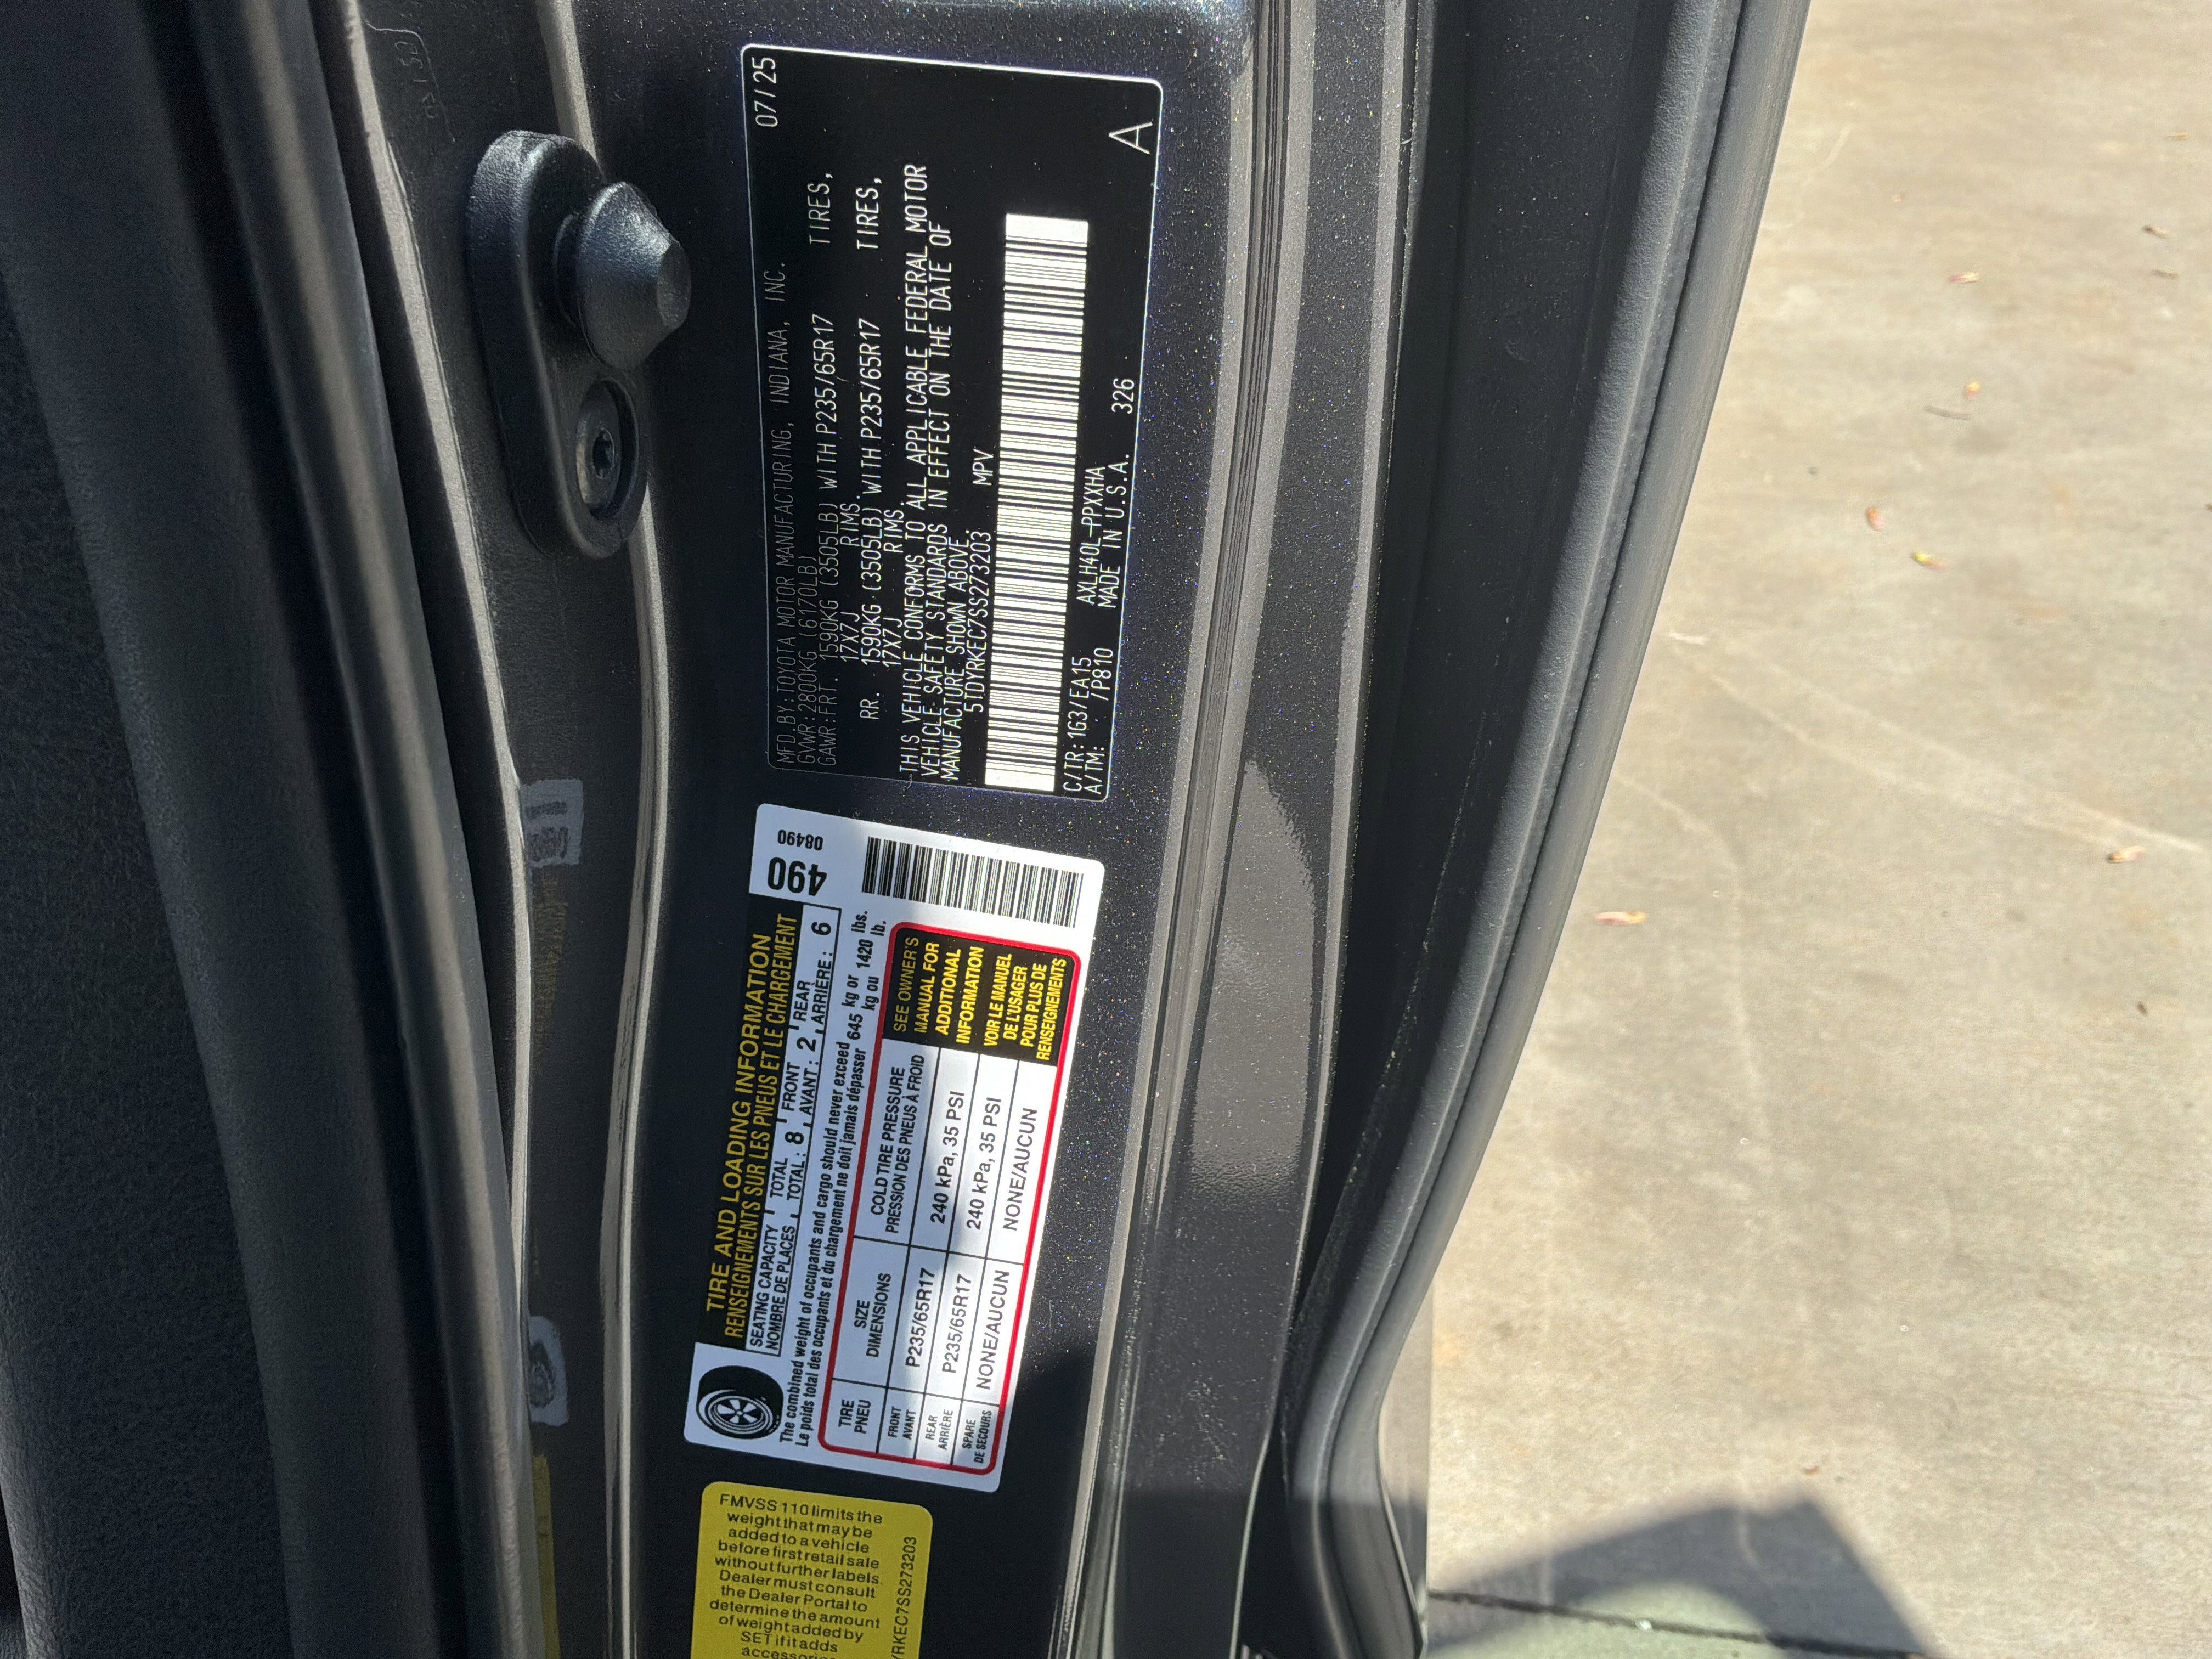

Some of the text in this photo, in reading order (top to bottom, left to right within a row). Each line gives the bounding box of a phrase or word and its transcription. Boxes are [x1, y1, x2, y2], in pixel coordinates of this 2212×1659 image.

[752, 56, 778, 127] 07/25
[1108, 119, 1153, 154] A
[763, 261, 798, 627] MOTOR MANUFACTURING, INDIANA, INC.
[807, 171, 839, 661] 1590KG (3505LB) WITH P235/65R17 TIRES,
[856, 176, 882, 719] RR. 1590KG (3505LB) WITH P235/65R17 TIRES,
[900, 163, 928, 773] THIS VEHICLE CONFORMS TO ALL APPLICABLE FEDERAL MOTOR
[921, 220, 952, 777] VEHICLE SAFETY STANDARDS IN EFFECT ON THE DATE OF
[1097, 378, 1135, 607] MADE IN U.S.A. 326
[1076, 465, 1105, 605] AXLH40L-PPXXHA
[796, 556, 818, 637] (6170LB)
[839, 494, 860, 662] 17X7J RIMS.
[964, 449, 994, 712] 5TDYRKEC7SS273203 MPV
[940, 528, 969, 782] MANUFACTURE SHOWN ABOVE.
[767, 856, 828, 898] 490
[777, 829, 823, 851] 08490
[810, 921, 832, 936] 6
[851, 909, 867, 933] lbs.
[855, 938, 873, 969] 1420
[793, 980, 810, 1021] REAR
[841, 974, 860, 1007] kg or
[893, 936, 919, 1032] SEE OWNER'S
[914, 941, 940, 1032] MANUAL FOR
[934, 946, 961, 1035] ADDITIONAL
[955, 946, 984, 1043] INFORMATION
[983, 951, 1012, 1047] VOIR LE MANUEL
[1003, 965, 1028, 1040] DE L'USAGER
[1020, 962, 1047, 1047] POUR PLUS DE
[1036, 957, 1066, 1060] RENSEIGNEMENTS
[796, 1036, 816, 1052] 2
[846, 1013, 864, 1041] 645
[707, 934, 771, 1313] TIRE AND LOADING INFORMATION
[724, 911, 799, 1338] RENSEIGNEMENTS SUR LES PNEUS ET LE CHARGEMENT
[781, 1061, 800, 1111] FRONT
[769, 1155, 788, 1199] TOTAL
[784, 1130, 804, 1145] 8
[870, 1066, 905, 1216] COLD TIRE PRESSURE
[885, 1054, 924, 1233] PRESSION DES PNEUS À FROID
[930, 1091, 965, 1224] 240 kPa, 35 PSI
[966, 1097, 1001, 1229] 240 kPa, 35 PSI
[1002, 1108, 1037, 1231] NONE/AUCUN
[779, 1041, 850, 1444] The combined weight of occupants and cargo should never exceed
[749, 1224, 778, 1347] SEATING CAPACITY
[765, 1224, 795, 1350] NOMBRE DE PLACES
[853, 1299, 870, 1328] SIZE
[866, 1272, 891, 1357] DIMENSIONS
[905, 1266, 936, 1368] P235/65R17
[941, 1273, 972, 1373] P235/65R17
[975, 1269, 1010, 1389] NONE/AUCUN
[838, 1398, 854, 1428] TIRE
[854, 1399, 871, 1434] PNEU
[887, 1407, 901, 1437] FRONT
[902, 1409, 916, 1439] AVANT
[961, 1419, 976, 1449] SPARE
[720, 1493, 882, 1524] FMVSS 110 limits the
[726, 1510, 872, 1539] weight that may be
[728, 1526, 870, 1553] added to vehicle
[714, 1554, 830, 1578] without further
[718, 1539, 879, 1569] before first retail sale
[719, 1569, 876, 1598] Dealer must consult
[720, 1584, 867, 1612] the Dealer Portal to
[791, 1608, 816, 1621] the
